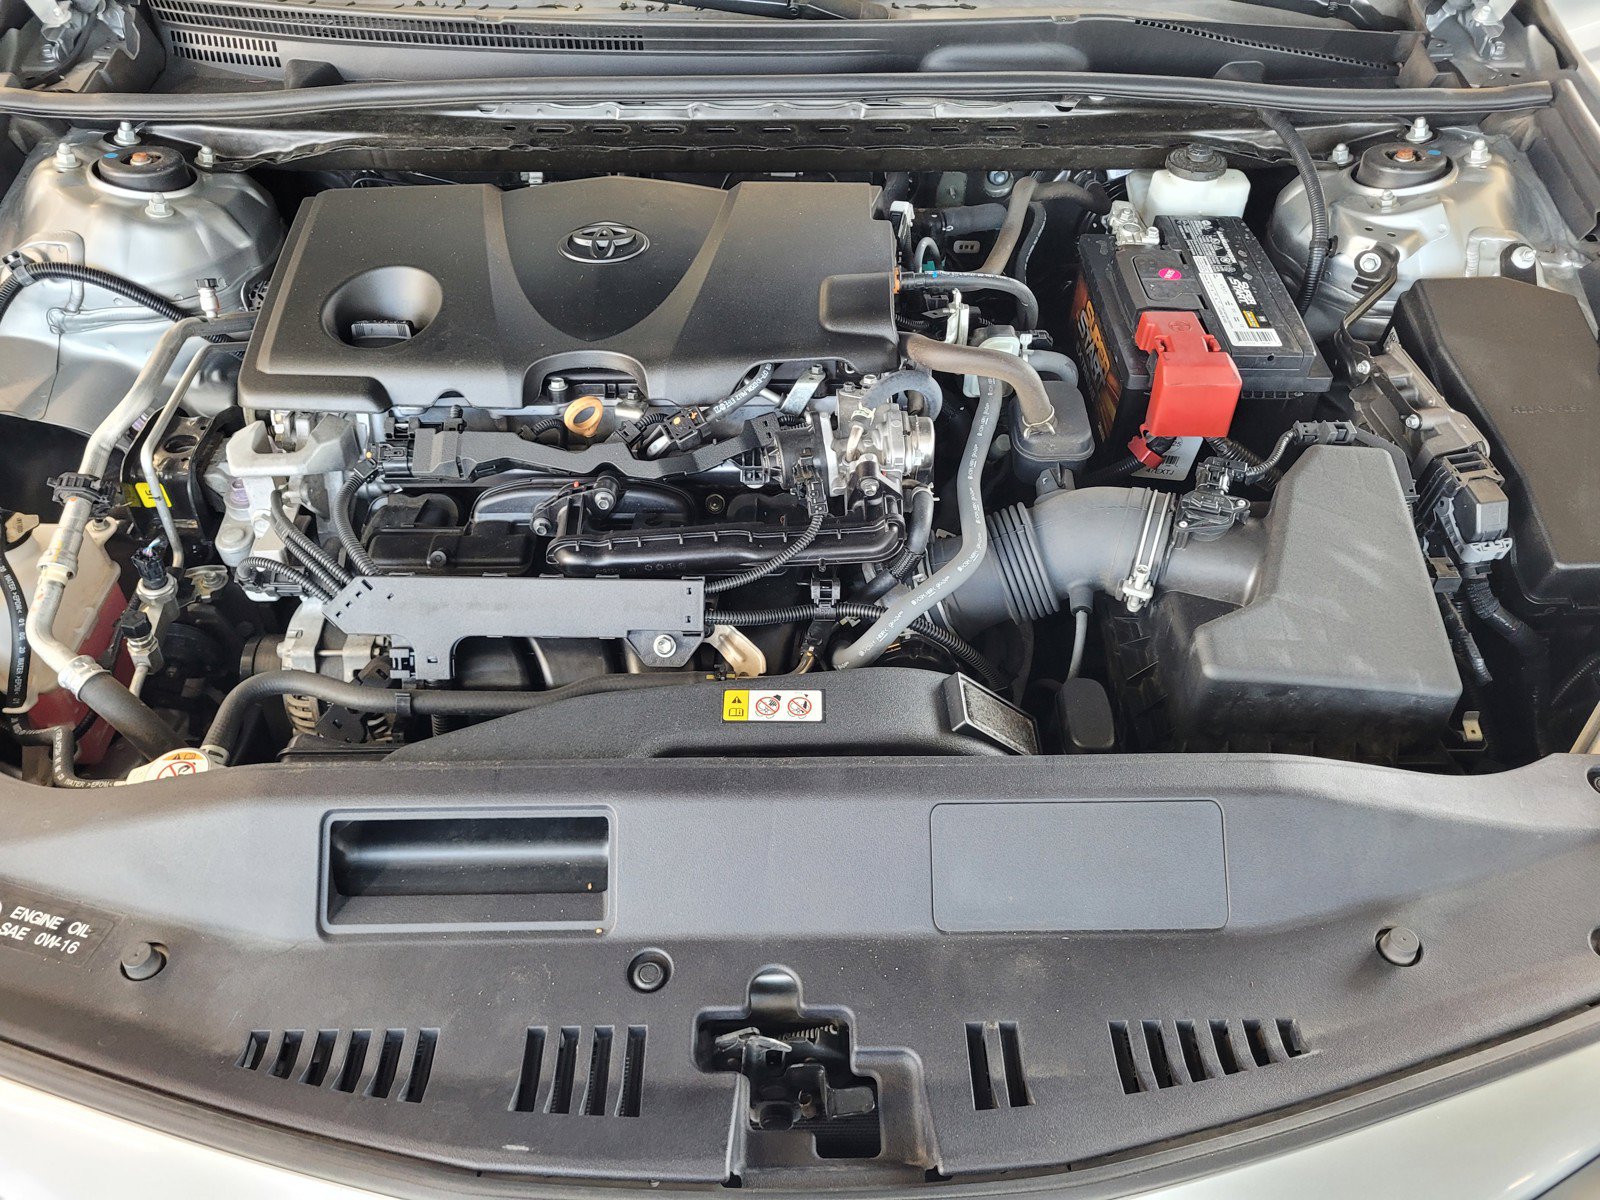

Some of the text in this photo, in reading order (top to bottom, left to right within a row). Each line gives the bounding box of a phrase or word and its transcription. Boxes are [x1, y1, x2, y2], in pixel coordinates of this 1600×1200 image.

[1227, 276, 1247, 304] START
[1241, 281, 1257, 305] SUPER
[1078, 309, 1106, 394] START
[1085, 300, 1110, 379] SUPER
[4, 574, 17, 591] WATER
[16, 657, 25, 675] WATER
[0, 922, 81, 954] SAE 0W-16
[9, 905, 92, 938] ENGINE OIL
